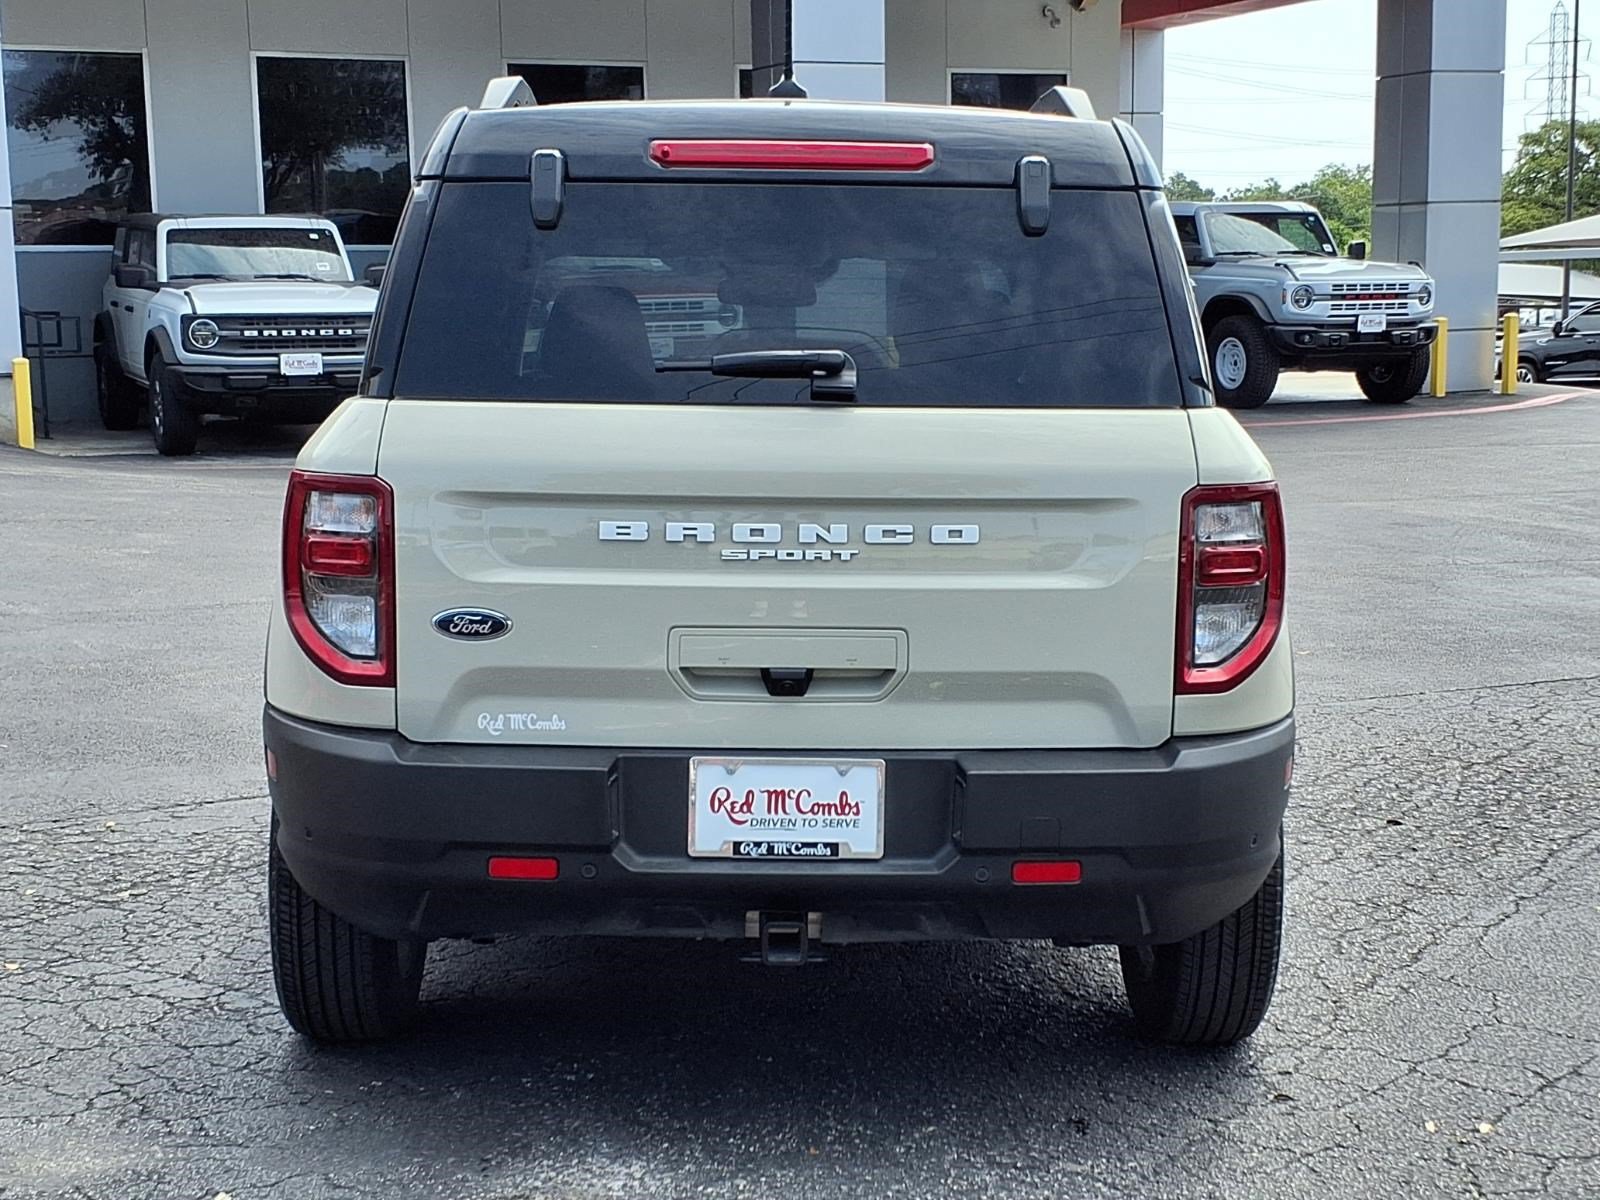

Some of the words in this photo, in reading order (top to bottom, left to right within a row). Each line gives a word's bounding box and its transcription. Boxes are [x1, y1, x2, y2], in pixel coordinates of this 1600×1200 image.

[599, 520, 980, 545] BRONCO
[720, 549, 859, 562] SPORT
[449, 614, 492, 633] Ford
[477, 712, 504, 735] Red
[506, 712, 566, 731] McCombs
[709, 786, 755, 825] Red
[759, 788, 861, 817] McCombs
[750, 817, 798, 828] DRIVEN
[801, 818, 818, 828] TO
[821, 818, 861, 829] SERVE
[740, 841, 768, 857] Red
[769, 841, 832, 856] McCombs
